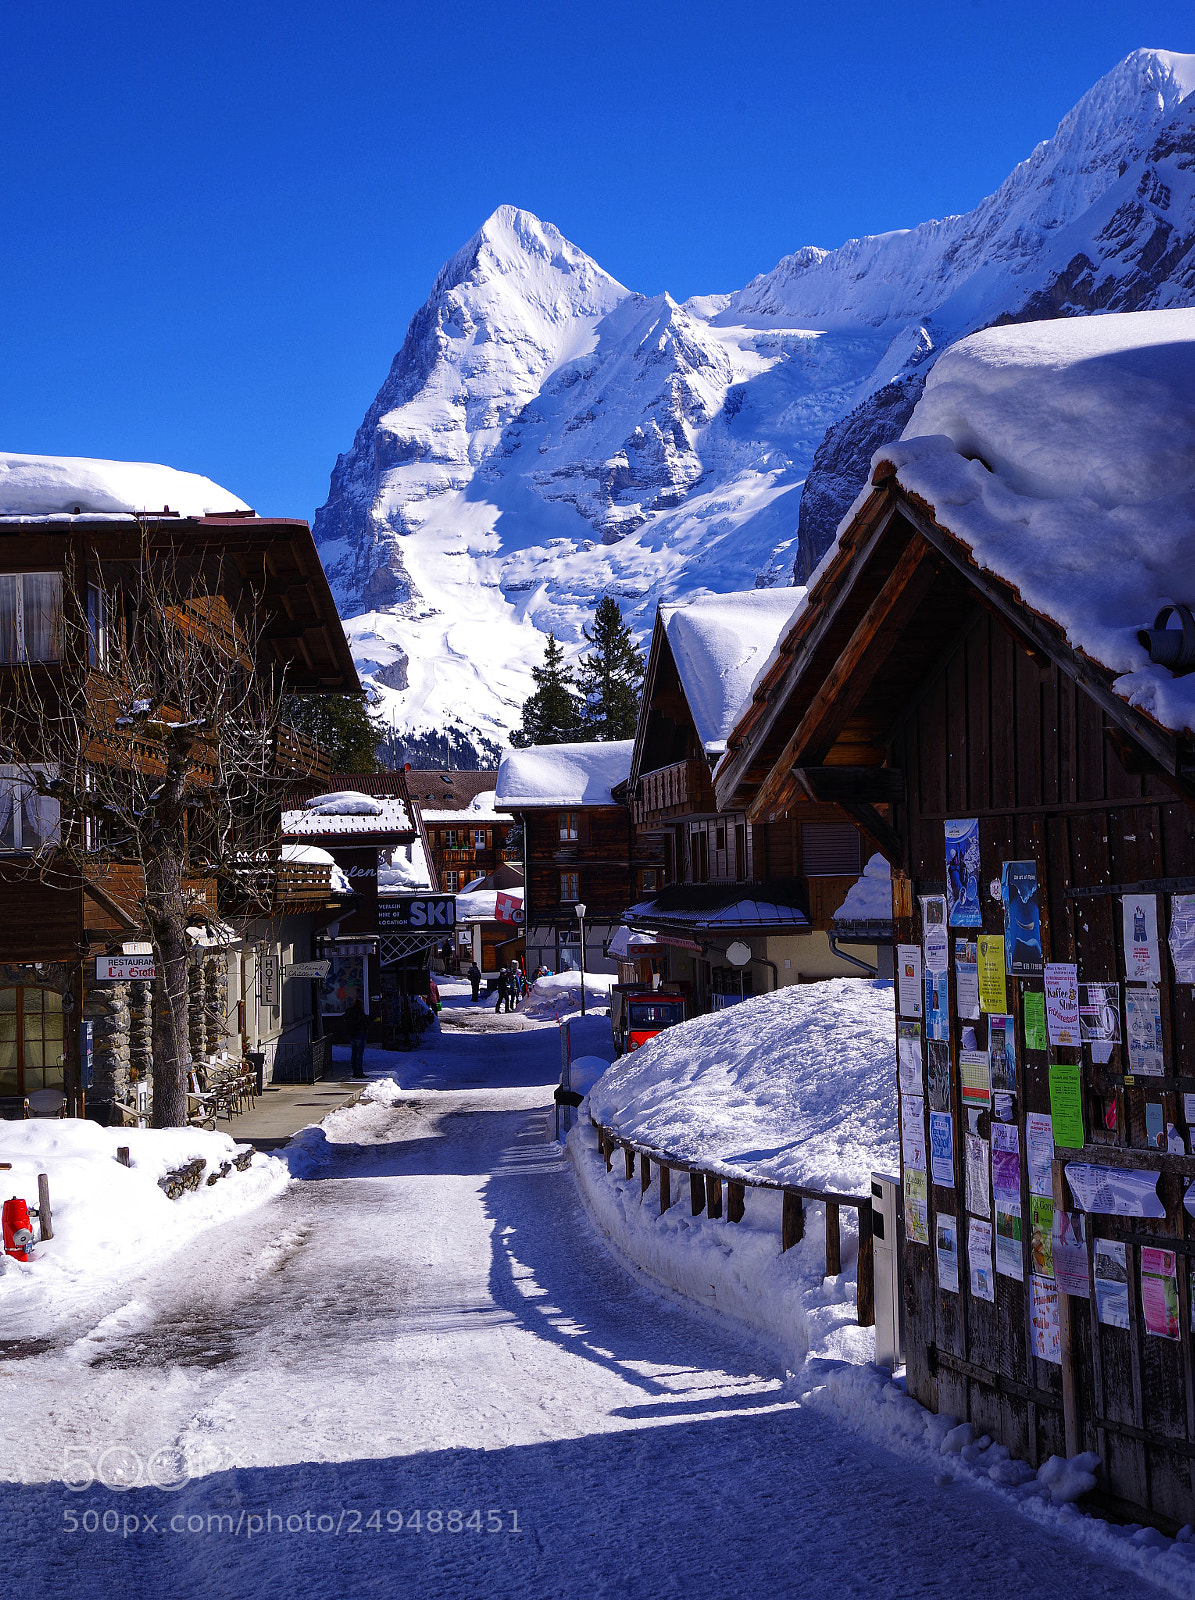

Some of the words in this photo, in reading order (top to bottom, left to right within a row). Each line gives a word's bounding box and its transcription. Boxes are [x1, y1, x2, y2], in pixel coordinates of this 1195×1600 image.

[409, 901, 455, 926] SKI
[630, 945, 663, 956] coop
[108, 966, 124, 978] La
[265, 959, 273, 1003] HOTEL
[1047, 987, 1068, 999] Kaffee
[1059, 999, 1078, 1011] Stube
